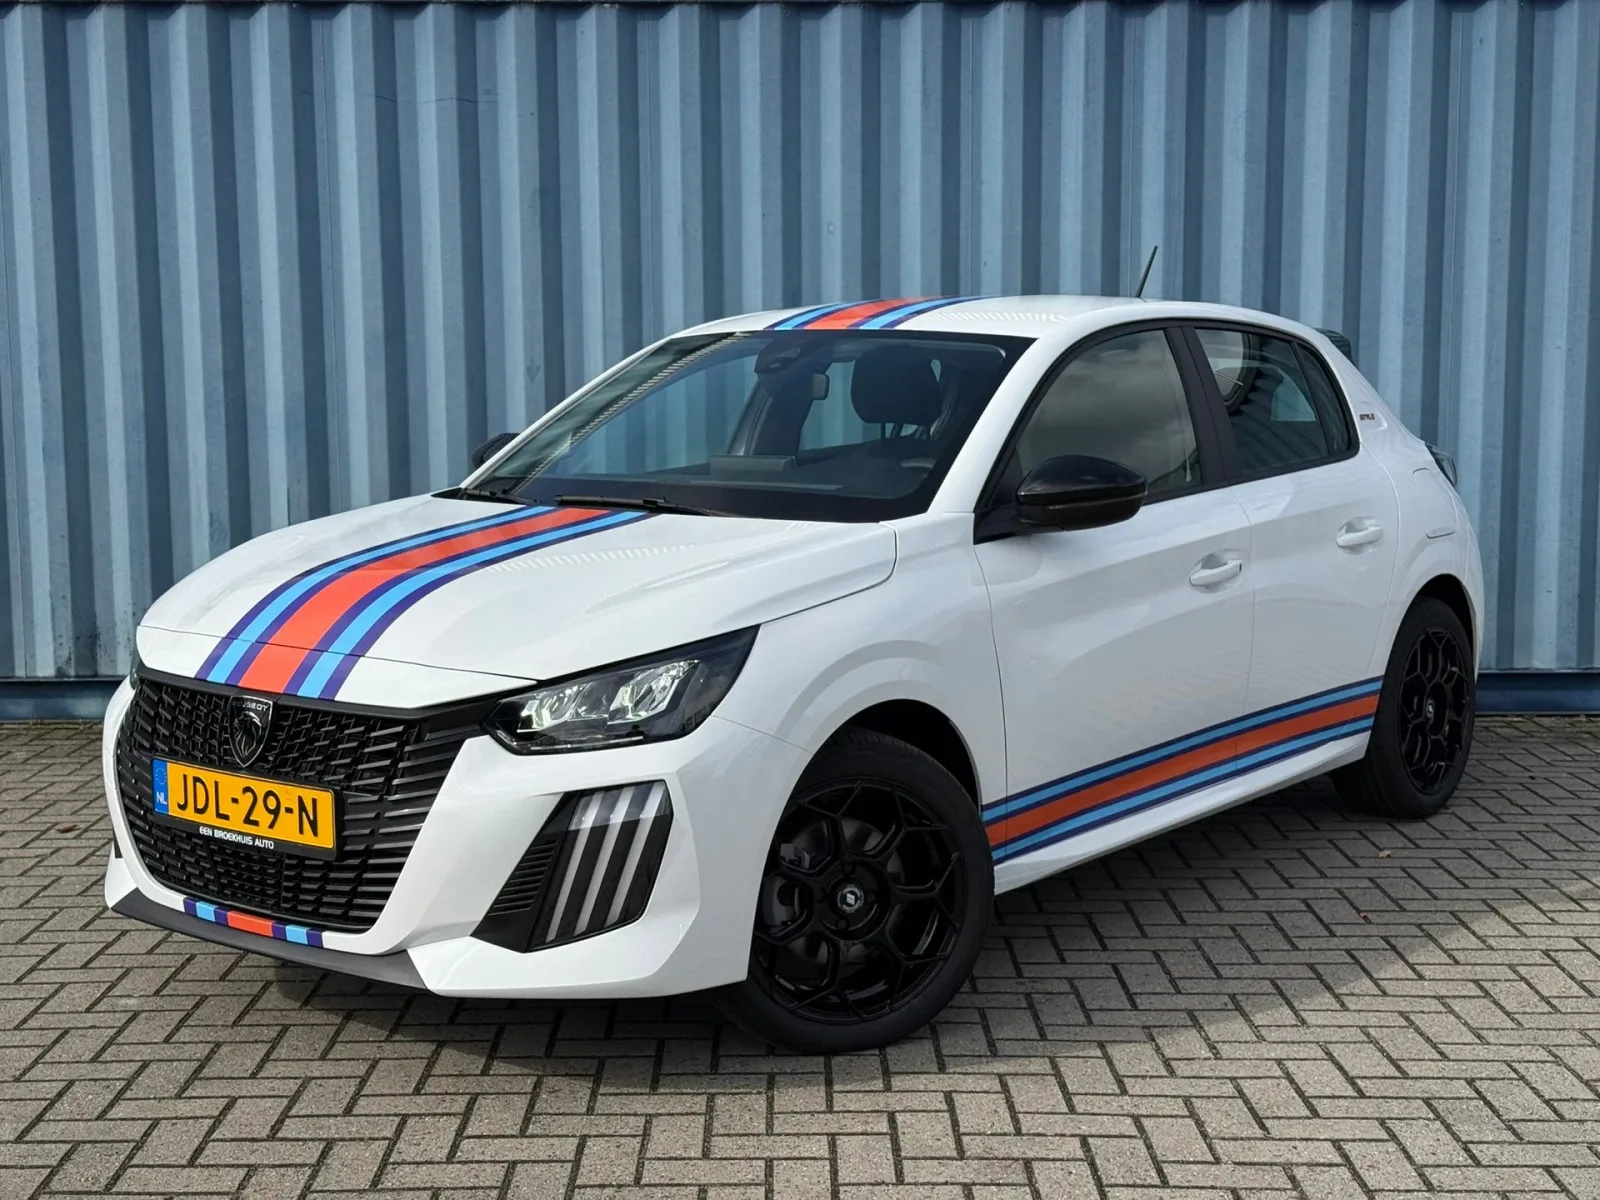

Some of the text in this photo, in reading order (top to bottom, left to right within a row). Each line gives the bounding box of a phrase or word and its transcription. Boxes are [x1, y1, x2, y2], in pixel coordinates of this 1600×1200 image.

[156, 791, 167, 805] NL
[177, 773, 318, 837] JDL-29-N
[199, 826, 274, 849] EEN BROEKHUIS AUTO
